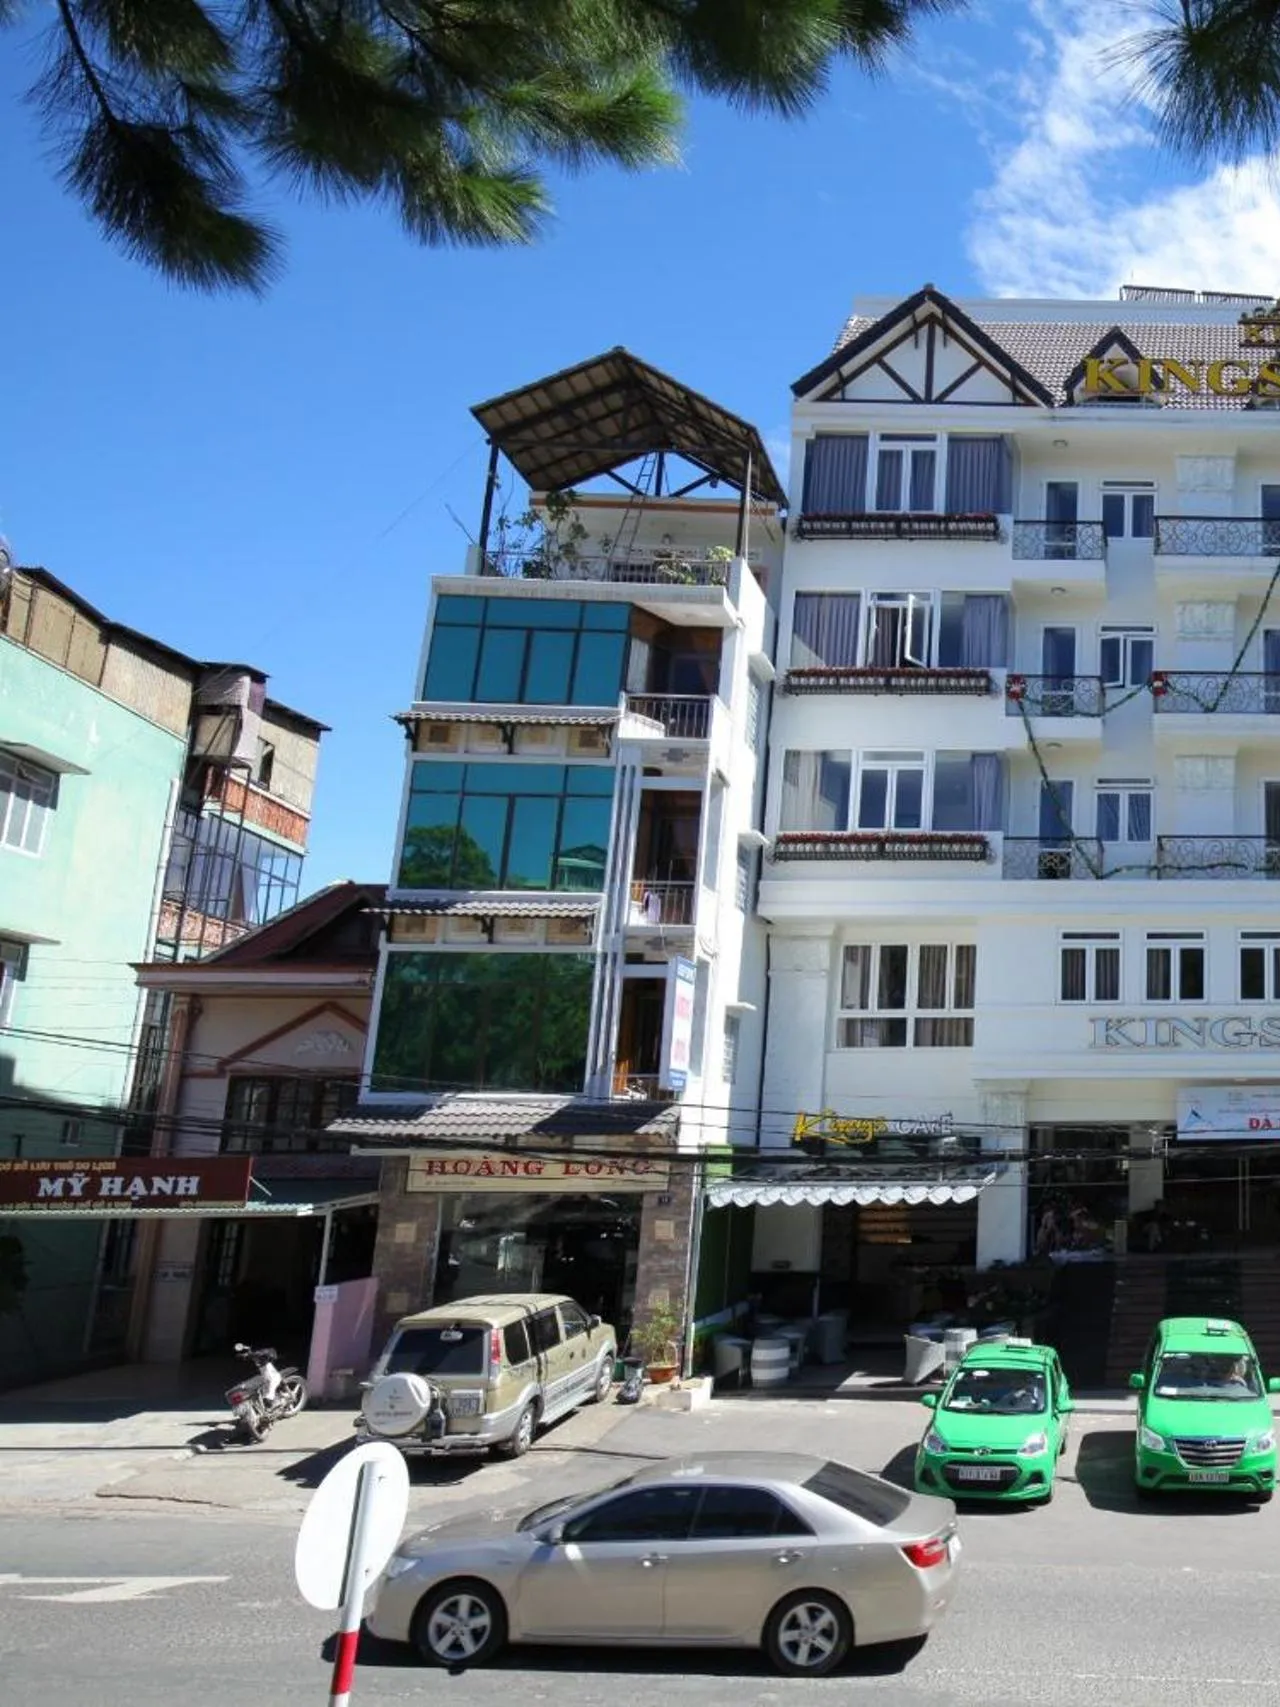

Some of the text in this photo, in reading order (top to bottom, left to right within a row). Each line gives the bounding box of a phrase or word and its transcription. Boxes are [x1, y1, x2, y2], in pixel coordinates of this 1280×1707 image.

[425, 1155, 545, 1176] HOÀNG
[37, 1172, 200, 1200] MỸ HẠNH
